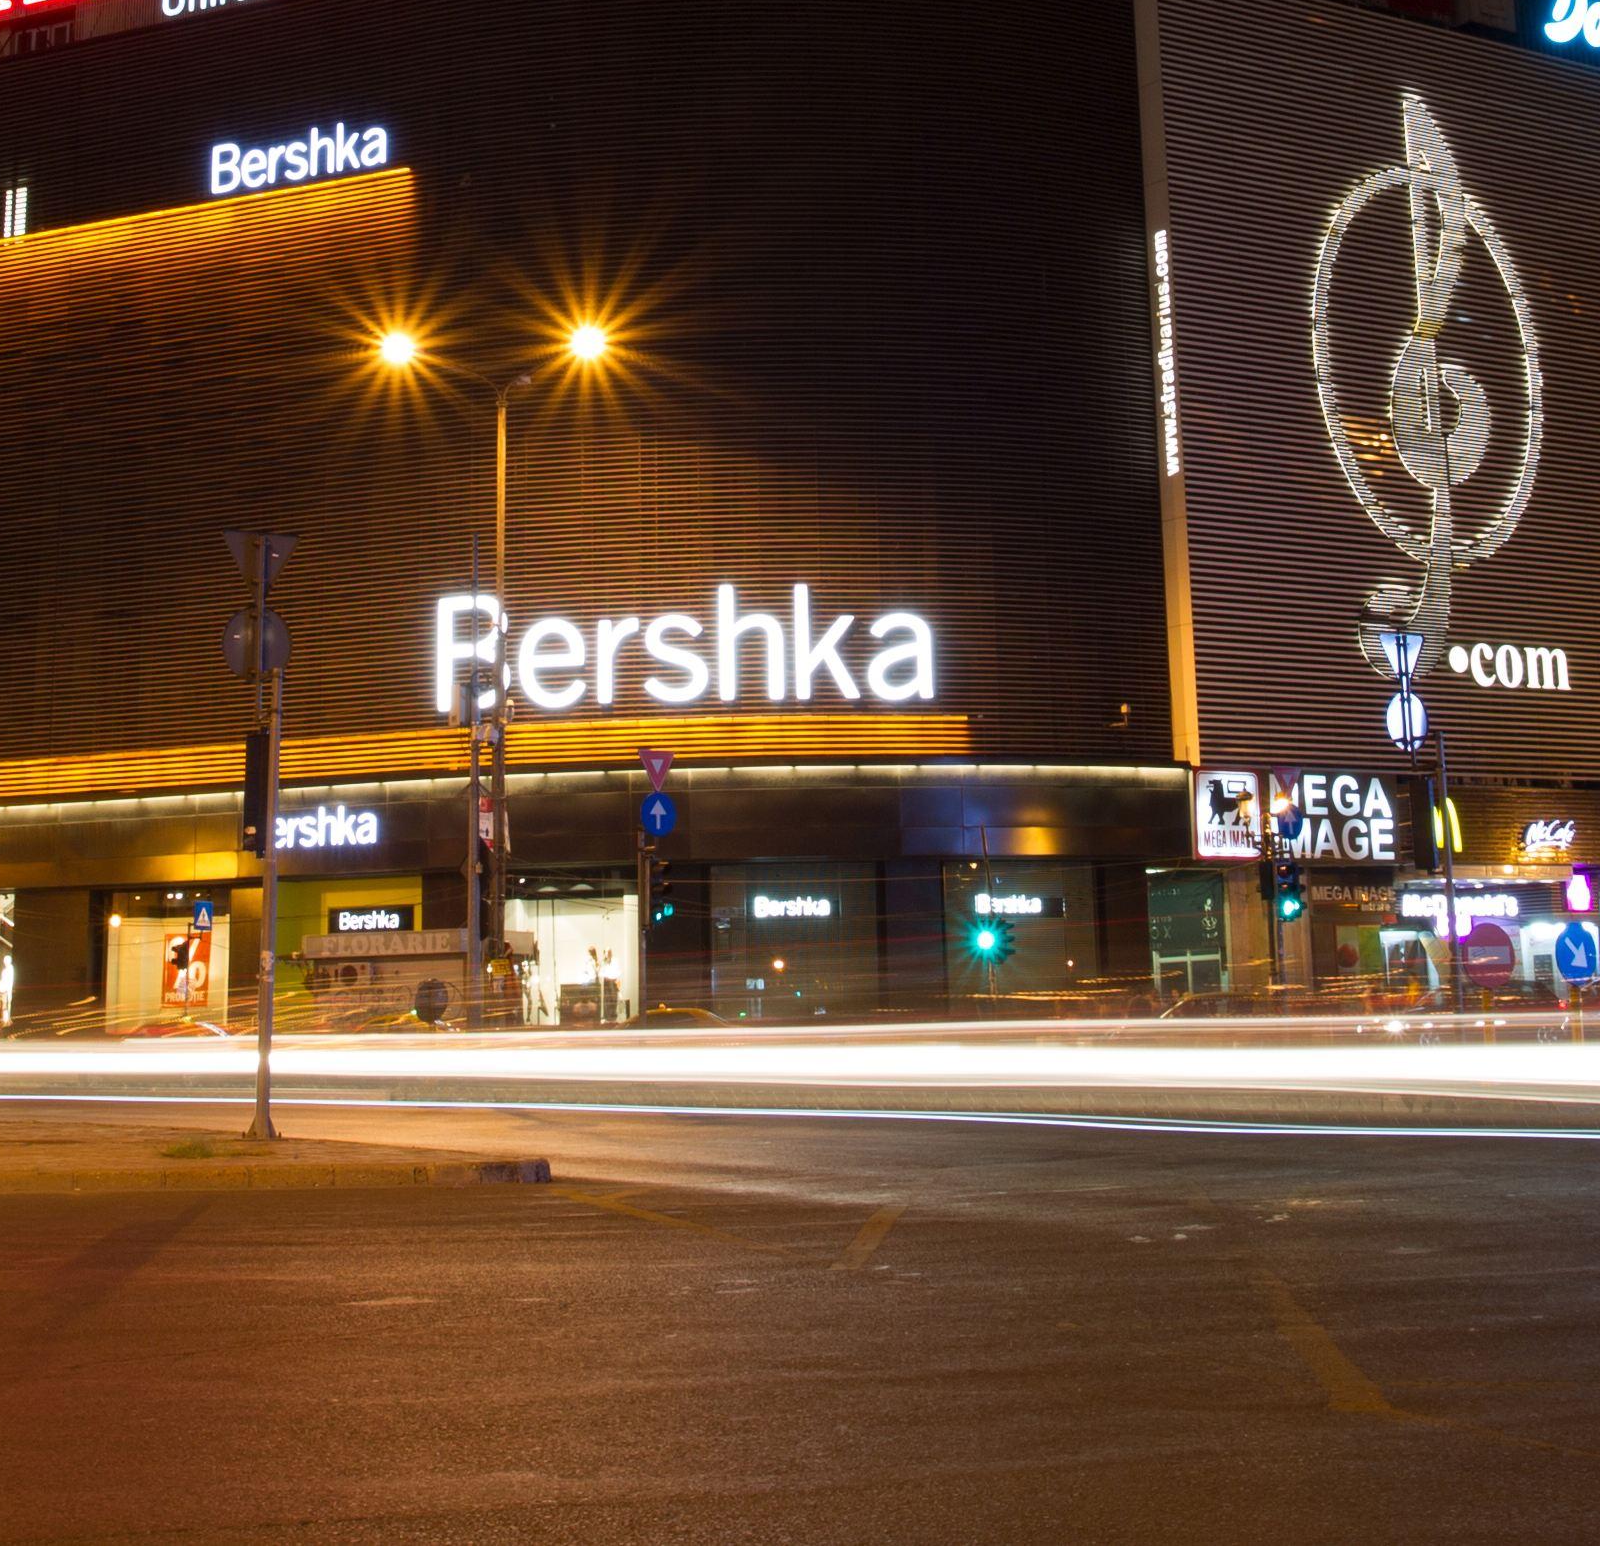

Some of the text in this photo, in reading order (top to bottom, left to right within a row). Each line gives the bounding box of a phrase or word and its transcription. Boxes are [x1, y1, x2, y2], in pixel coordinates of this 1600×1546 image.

[211, 123, 388, 196] Bershka
[436, 583, 936, 714] Bershka
[274, 805, 377, 849] ershka
[1203, 830, 1227, 849] MEGA
[1311, 885, 1397, 901] MEGA IMAGE
[754, 896, 830, 918] Bershka
[1402, 893, 1520, 918] McDnald's
[338, 909, 400, 931] Bershka
[322, 933, 451, 954] FLORARIE
